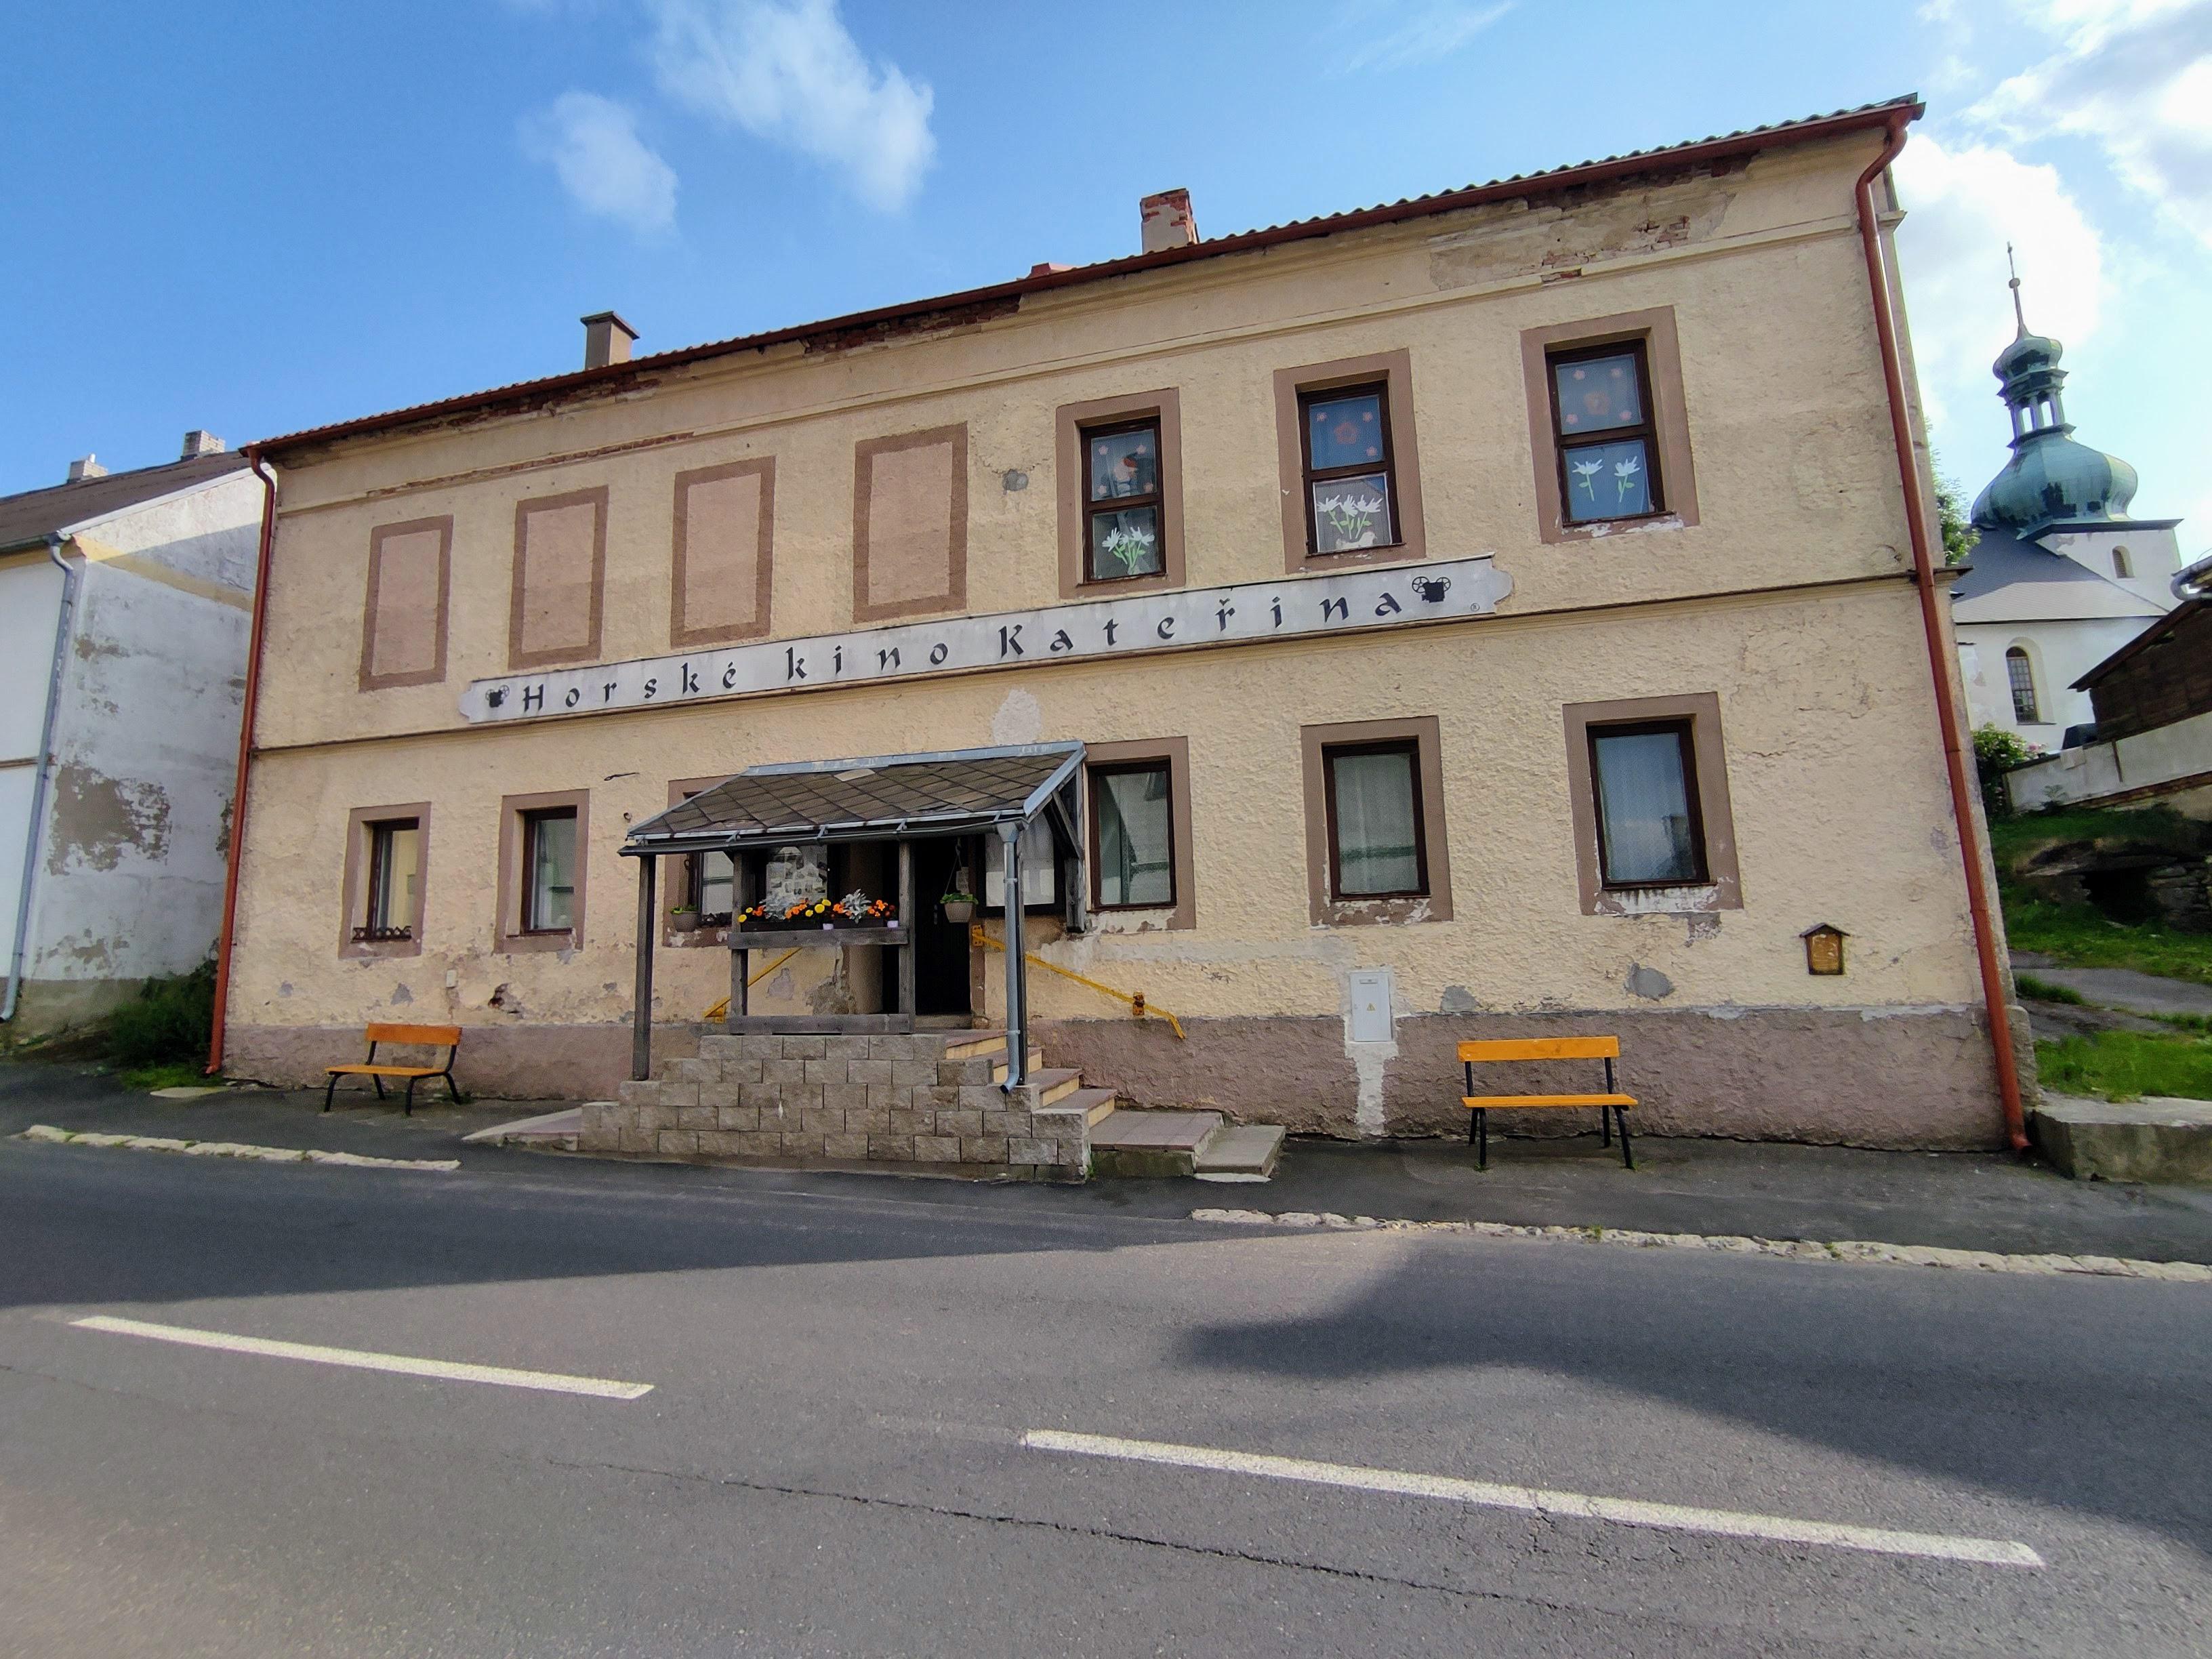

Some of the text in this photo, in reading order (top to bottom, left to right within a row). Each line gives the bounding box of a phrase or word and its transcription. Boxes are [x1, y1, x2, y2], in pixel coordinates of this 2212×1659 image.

[523, 592, 1402, 713] Horské kino Kateřina
